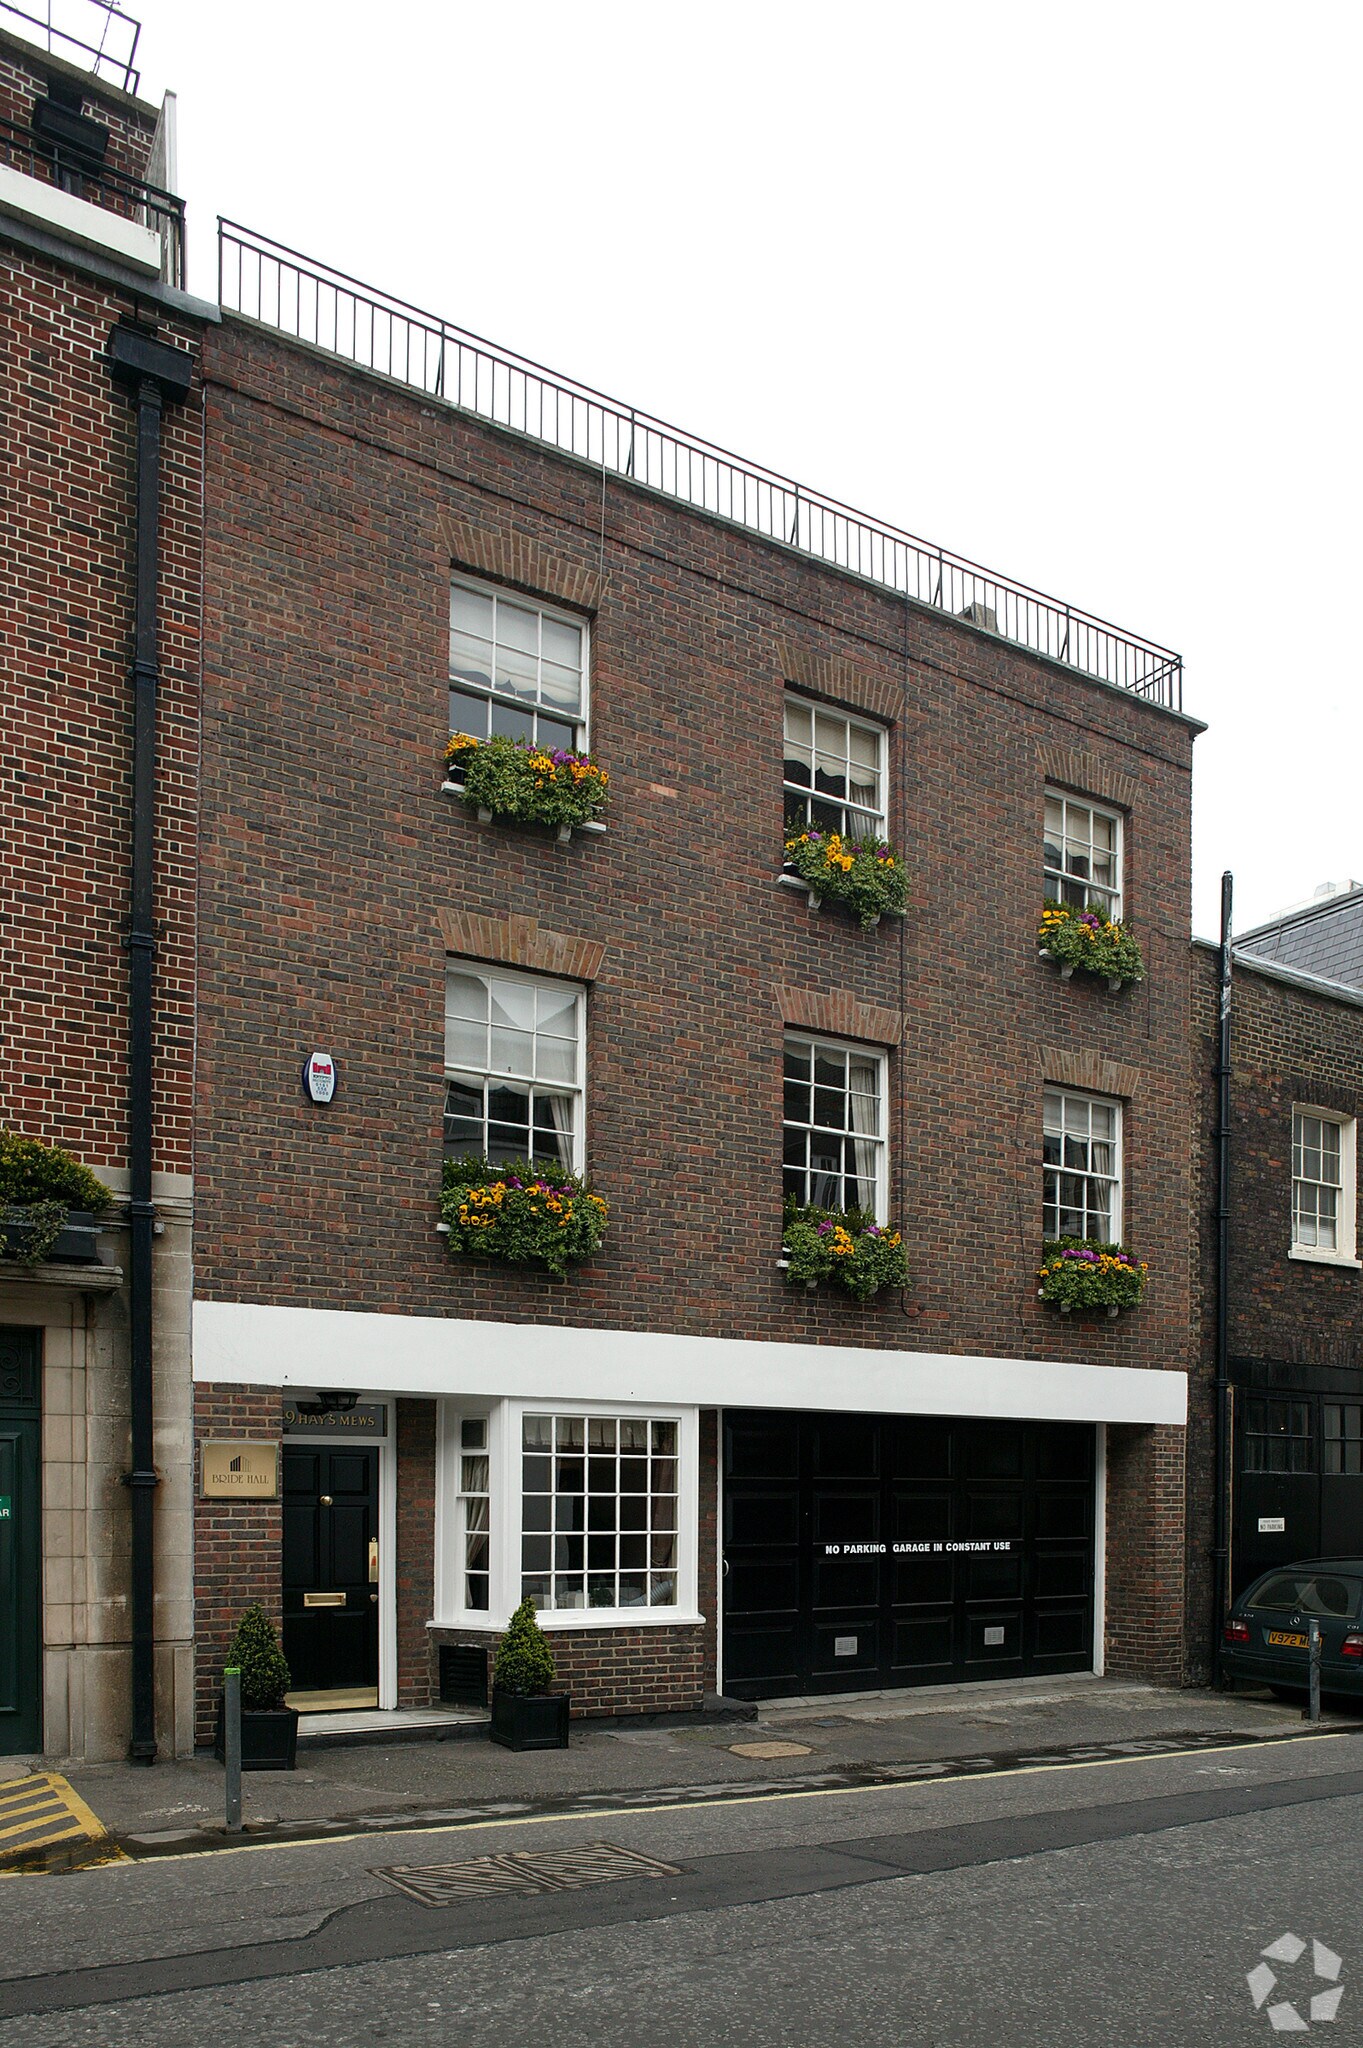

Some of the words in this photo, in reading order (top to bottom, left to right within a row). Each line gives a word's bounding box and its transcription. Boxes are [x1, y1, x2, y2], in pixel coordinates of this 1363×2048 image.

[339, 1415, 375, 1426] MEWS
[212, 1474, 244, 1484] BRIDE
[247, 1474, 269, 1484] HALL
[825, 1545, 840, 1555] NO
[843, 1544, 887, 1554] PARKING
[892, 1543, 931, 1553] GARAGE
[933, 1543, 944, 1552] IN
[945, 1542, 992, 1552] CONSTANT
[993, 1541, 1011, 1550] USE
[1271, 1633, 1297, 1645] V972
